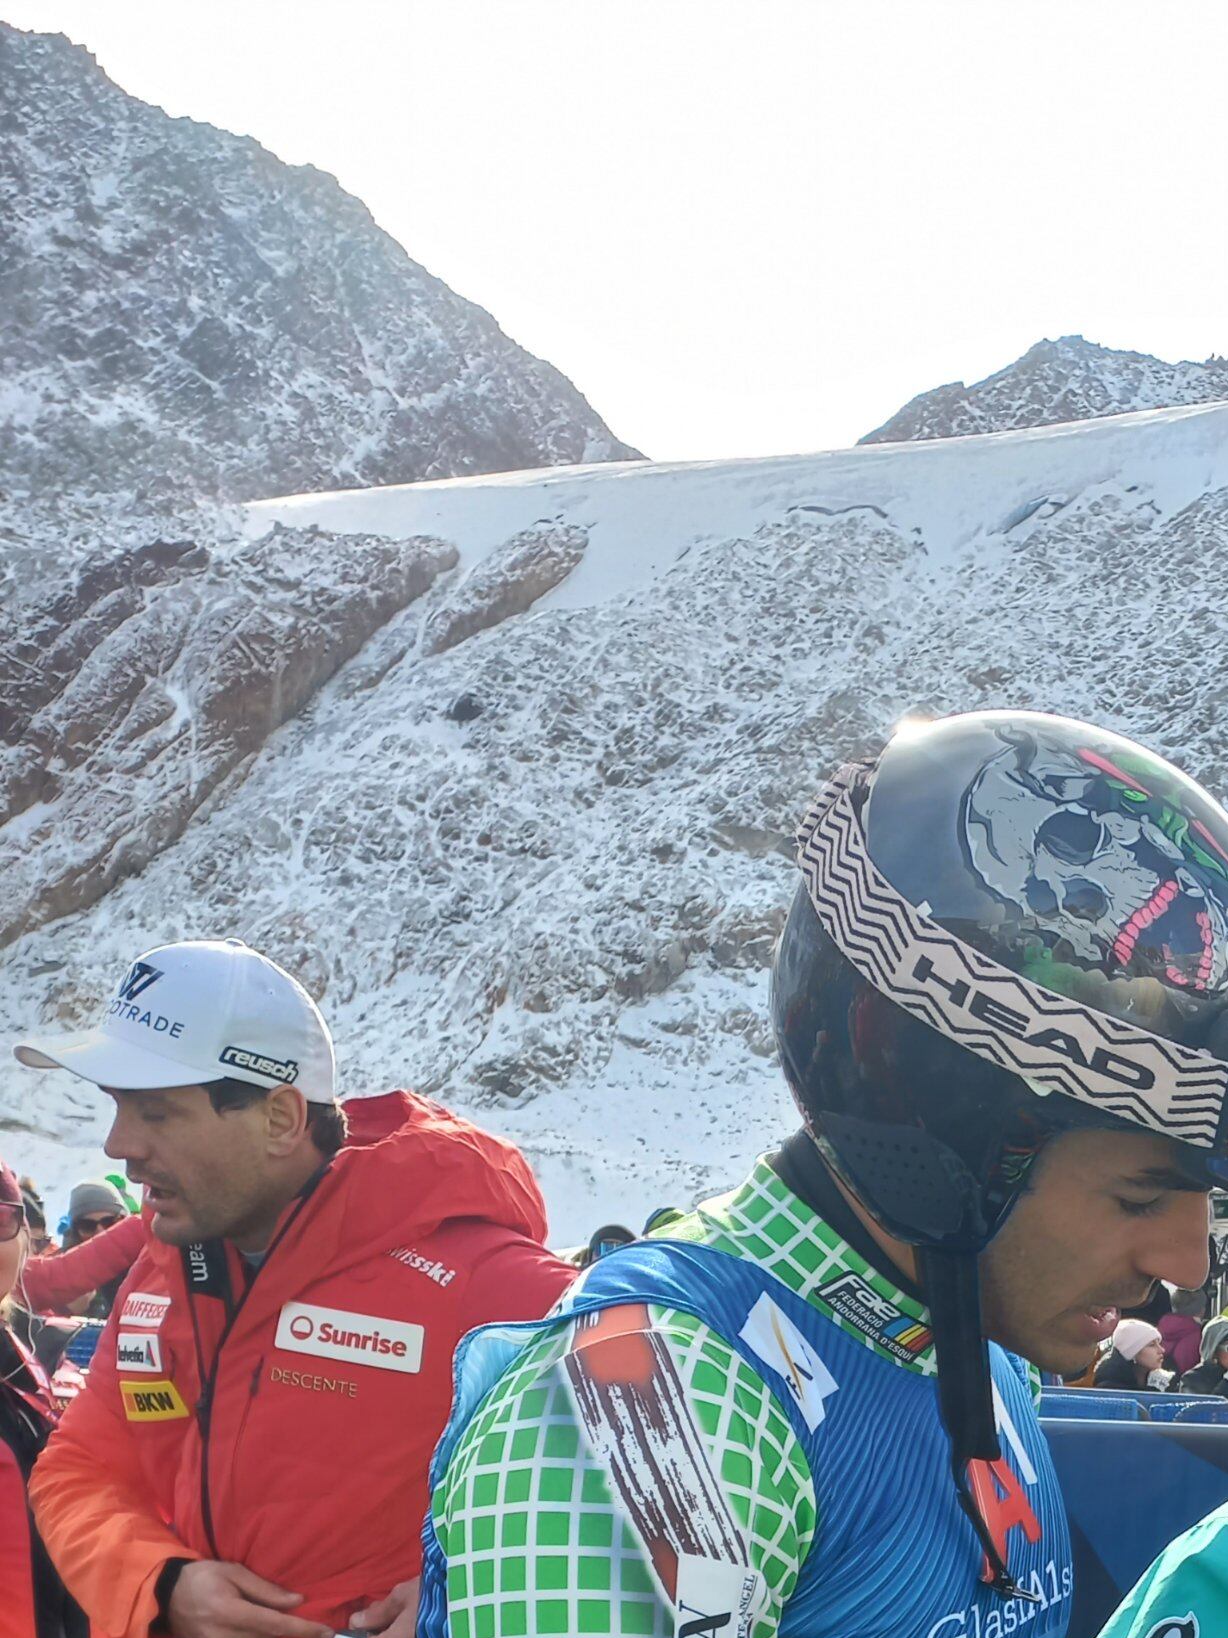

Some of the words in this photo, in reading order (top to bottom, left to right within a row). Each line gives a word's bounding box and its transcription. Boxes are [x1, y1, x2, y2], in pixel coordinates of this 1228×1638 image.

[911, 956, 1157, 1093] HEAD
[223, 1047, 299, 1083] reusch
[386, 1247, 456, 1288] wissski
[828, 1297, 881, 1340] ANDORRANA
[317, 1322, 407, 1358] Sunrise
[270, 1367, 358, 1398] DESCENTE
[133, 1391, 174, 1413] BKW
